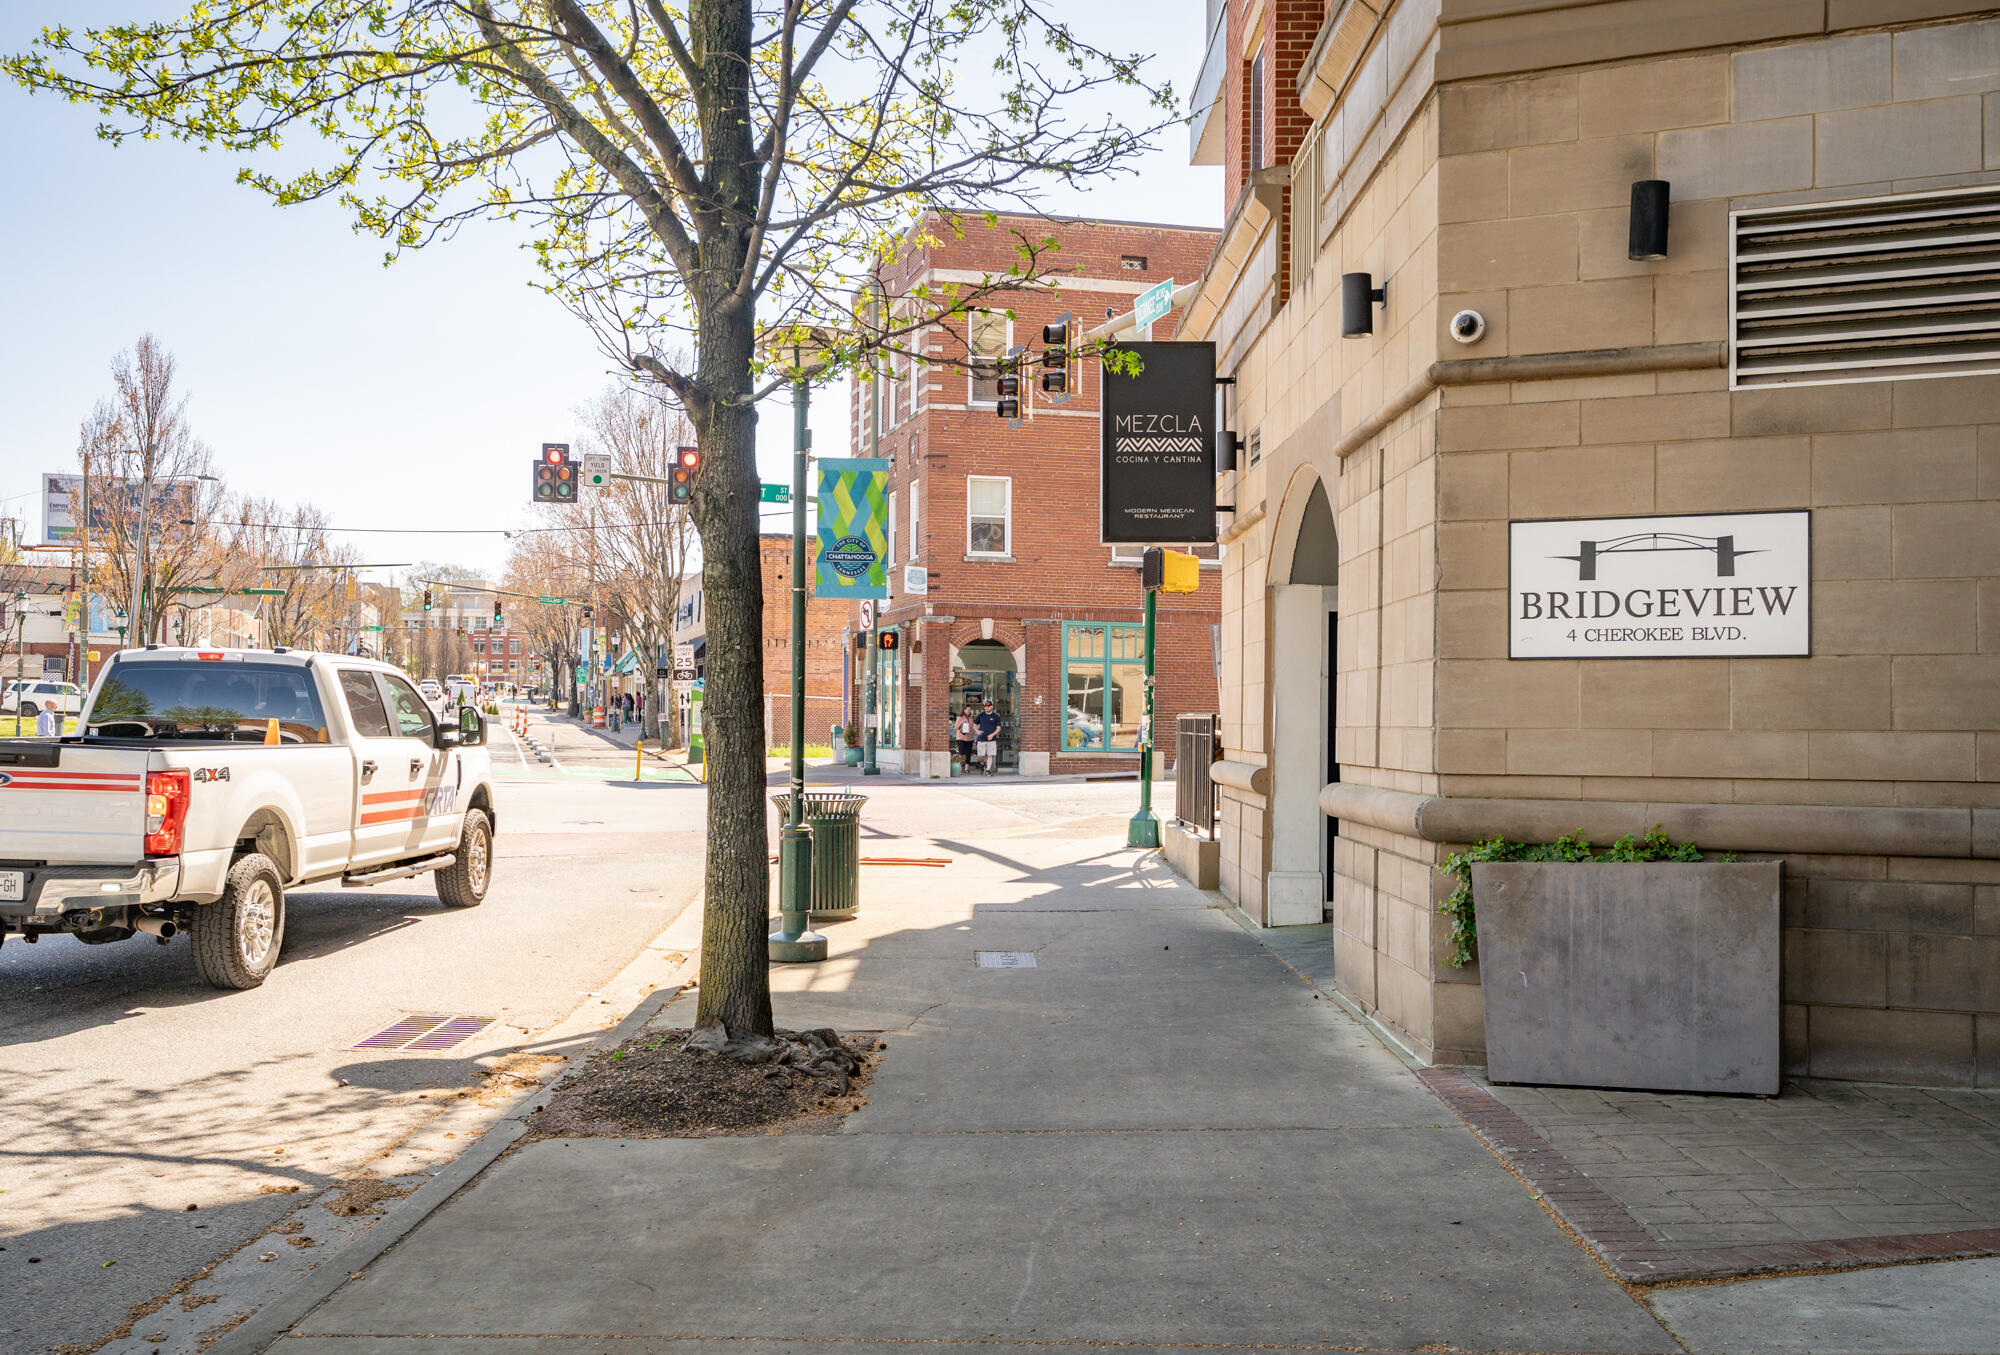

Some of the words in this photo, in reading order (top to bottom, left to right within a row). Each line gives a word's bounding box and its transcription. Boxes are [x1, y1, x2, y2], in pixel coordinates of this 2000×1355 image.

[1116, 414, 1202, 433] MEZCLA
[837, 540, 846, 548] THE
[836, 564, 867, 576] TENNESSEE
[1519, 585, 1798, 620] BRIDGEVIEW
[1566, 629, 1577, 642] 4
[1584, 627, 1684, 642] CHEROKEE
[1691, 626, 1747, 641] BLVD.
[676, 657, 692, 667] 25
[425, 786, 455, 816] CARTA
